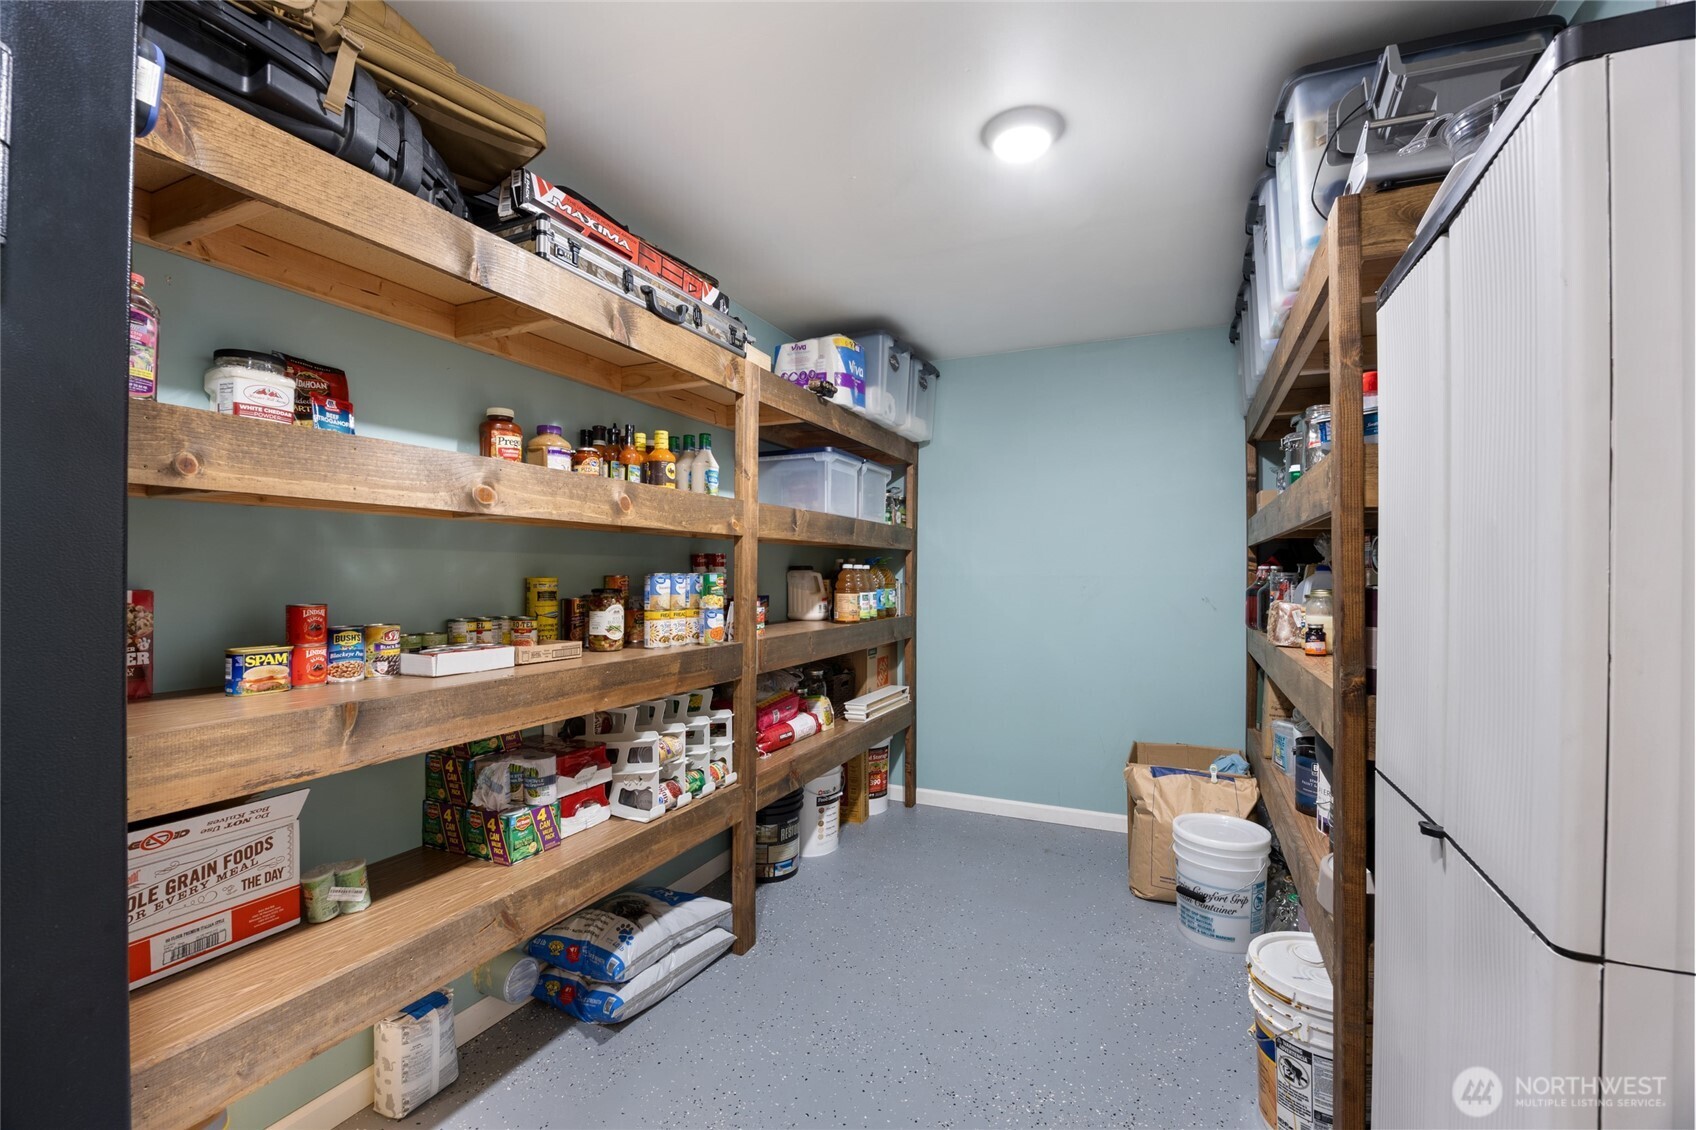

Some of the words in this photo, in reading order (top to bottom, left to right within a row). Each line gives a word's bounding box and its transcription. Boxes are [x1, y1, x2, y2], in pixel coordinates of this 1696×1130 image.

[550, 195, 633, 254] MAXIMA
[240, 404, 263, 412] WHITE
[264, 408, 293, 417] CHEDDAR
[254, 412, 281, 420] POWDER
[335, 632, 362, 643] BUSH'S
[245, 652, 288, 667] SPAM
[445, 760, 454, 773] 4
[250, 805, 271, 815] Box
[255, 811, 270, 820] Do
[443, 809, 452, 822] 4
[537, 808, 547, 821] 4
[207, 811, 247, 826] Knives
[224, 817, 252, 830] NOT
[487, 818, 496, 831] 4
[539, 820, 551, 830] CAN
[200, 825, 221, 834] Use
[489, 832, 500, 841] CAN
[165, 860, 218, 896] GRAIN
[223, 835, 274, 871] FOODS
[154, 879, 210, 913] EVERY
[216, 858, 259, 884] MEAL
[241, 873, 262, 892] THE
[264, 866, 285, 884] DAY
[1230, 893, 1249, 908] Grip
